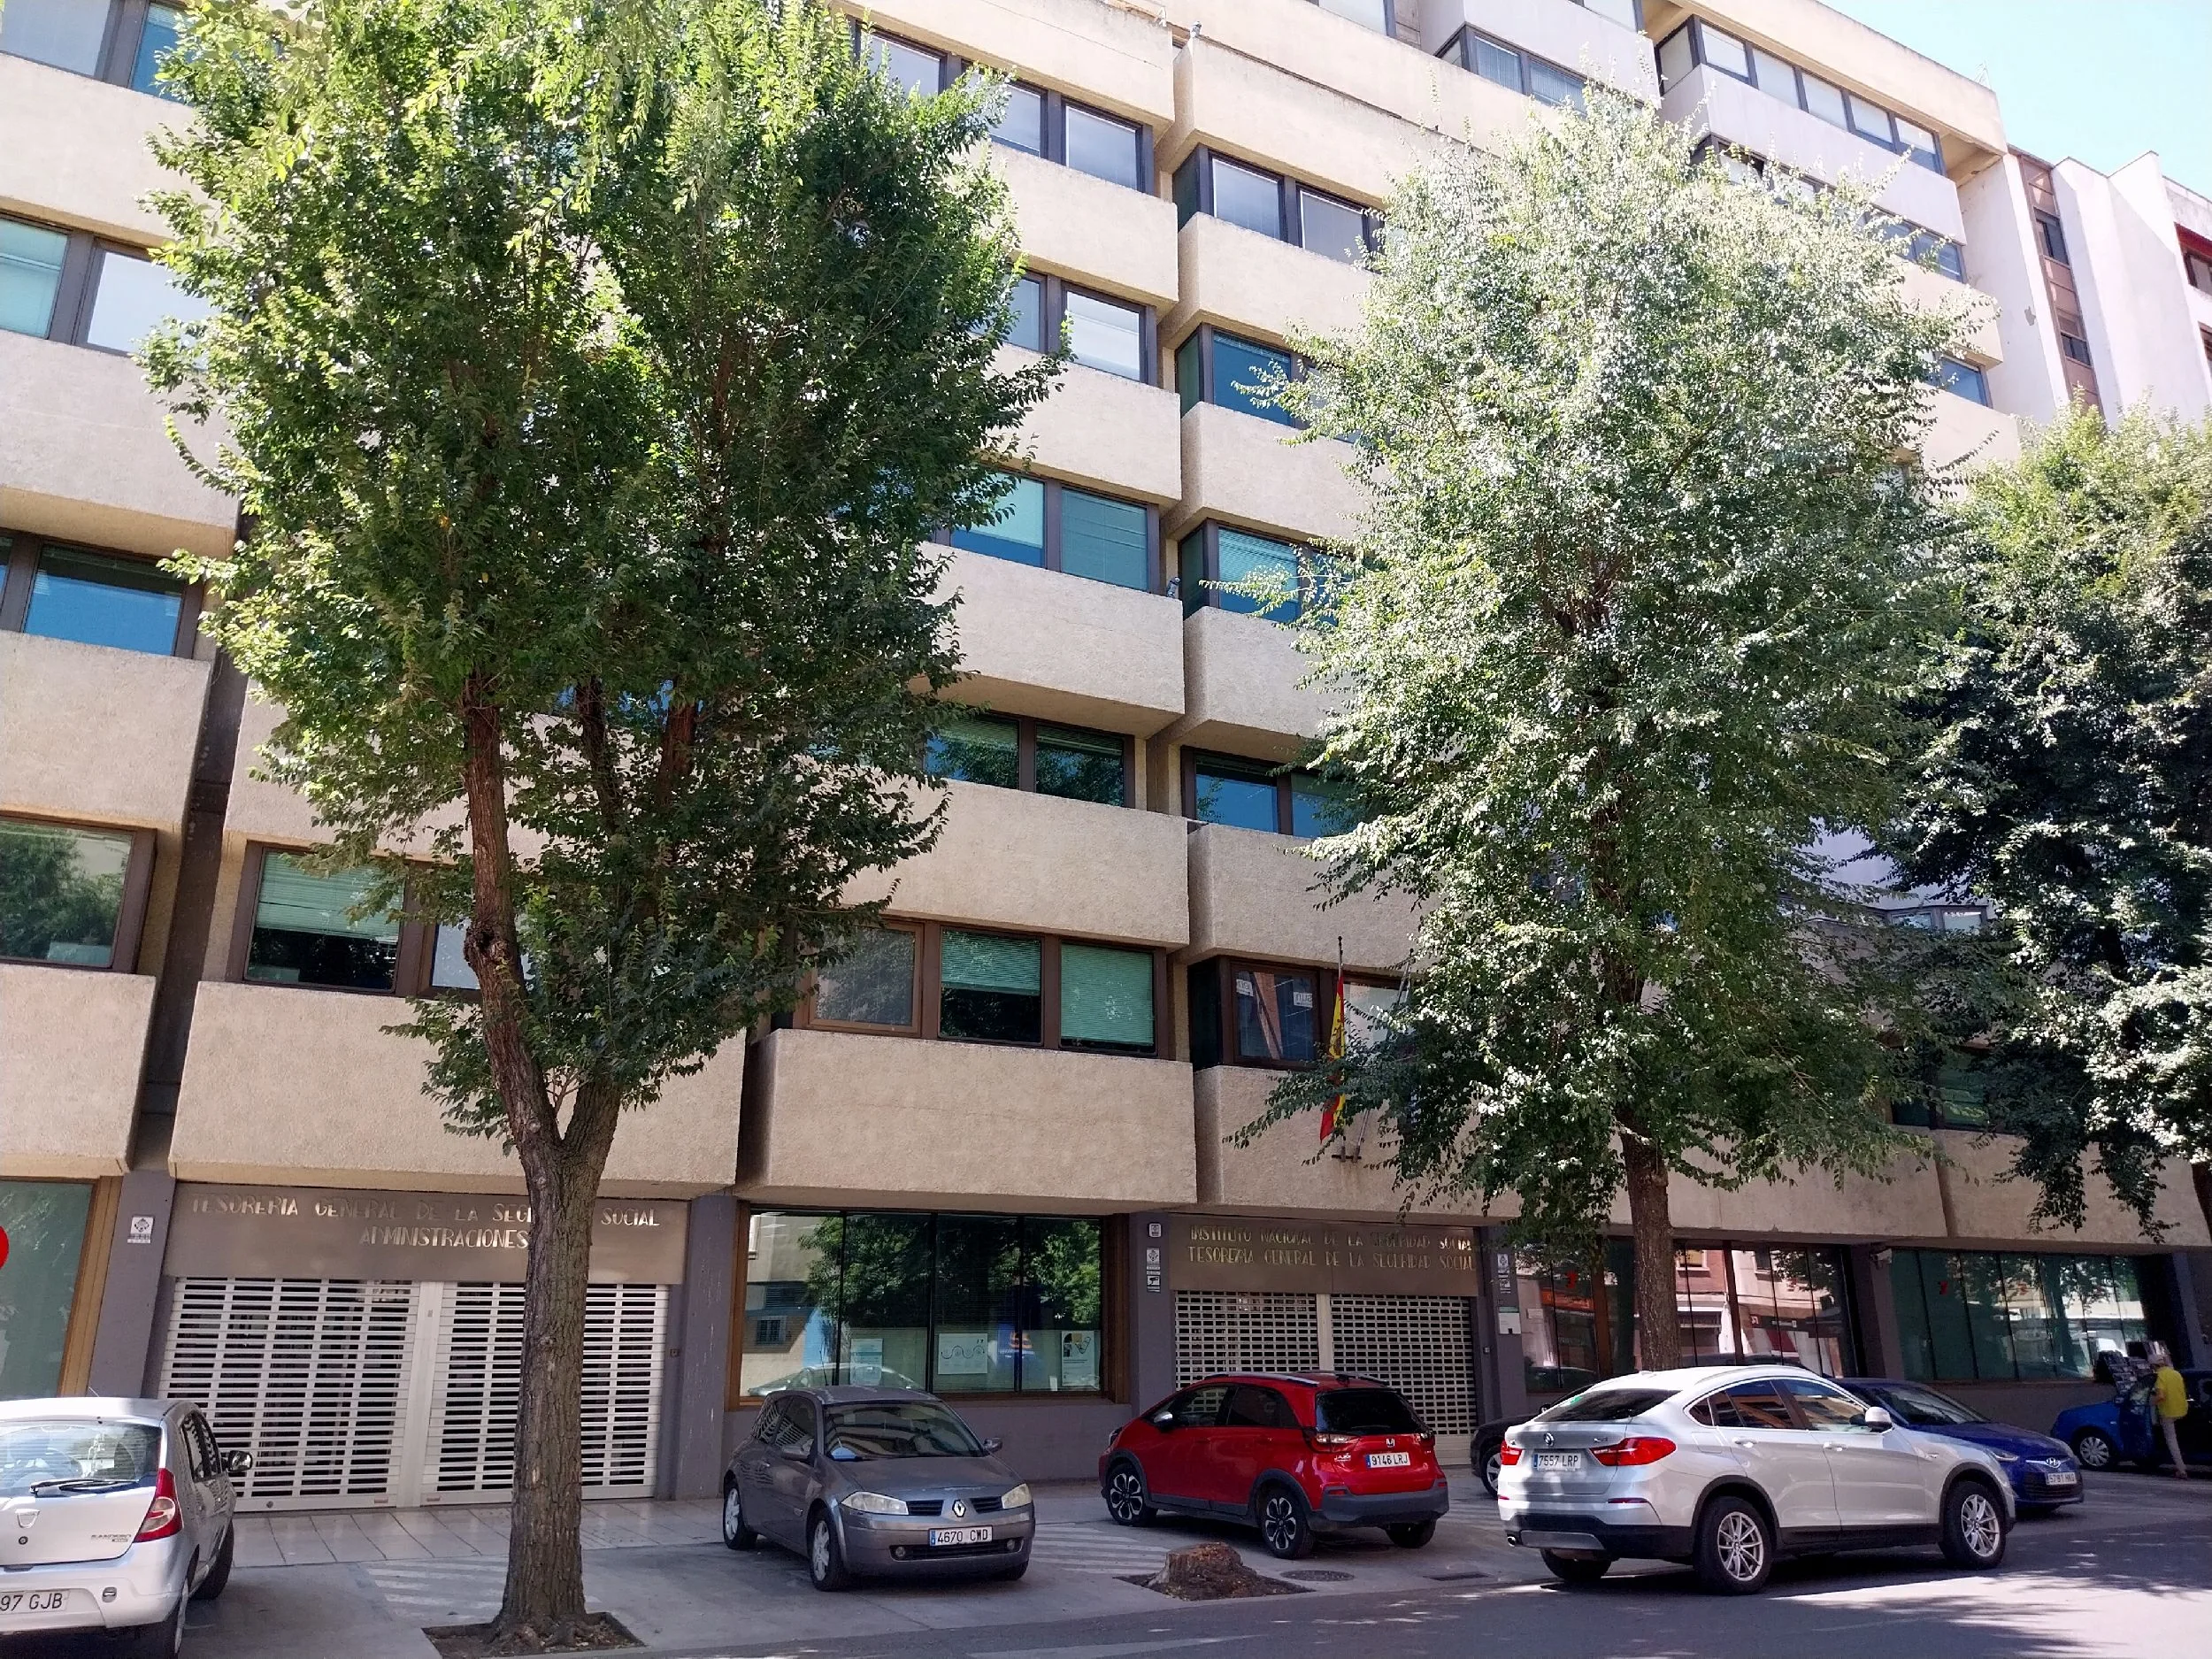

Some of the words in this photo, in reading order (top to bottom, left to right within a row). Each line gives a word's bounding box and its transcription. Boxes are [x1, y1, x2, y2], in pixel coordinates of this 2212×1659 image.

[315, 1197, 402, 1218] GENERAL
[417, 1200, 442, 1220] DE
[455, 1207, 479, 1221] LA
[602, 1208, 660, 1225] SOCIAL
[358, 1225, 529, 1248] ADMINISTRACIONES
[1348, 1233, 1363, 1247] LA
[1263, 1248, 1317, 1265] GENERAL
[1325, 1251, 1340, 1267] DE
[1349, 1253, 1364, 1267] LA
[1439, 1255, 1476, 1271] SOCIAL
[1371, 1455, 1392, 1465] 9146
[1394, 1454, 1408, 1464] LRJ
[1539, 1455, 1559, 1466] 7557
[1563, 1455, 1578, 1466] LRP
[938, 1531, 963, 1543] 4670
[971, 1529, 987, 1540] CWD
[29, 1593, 63, 1609] GJB
